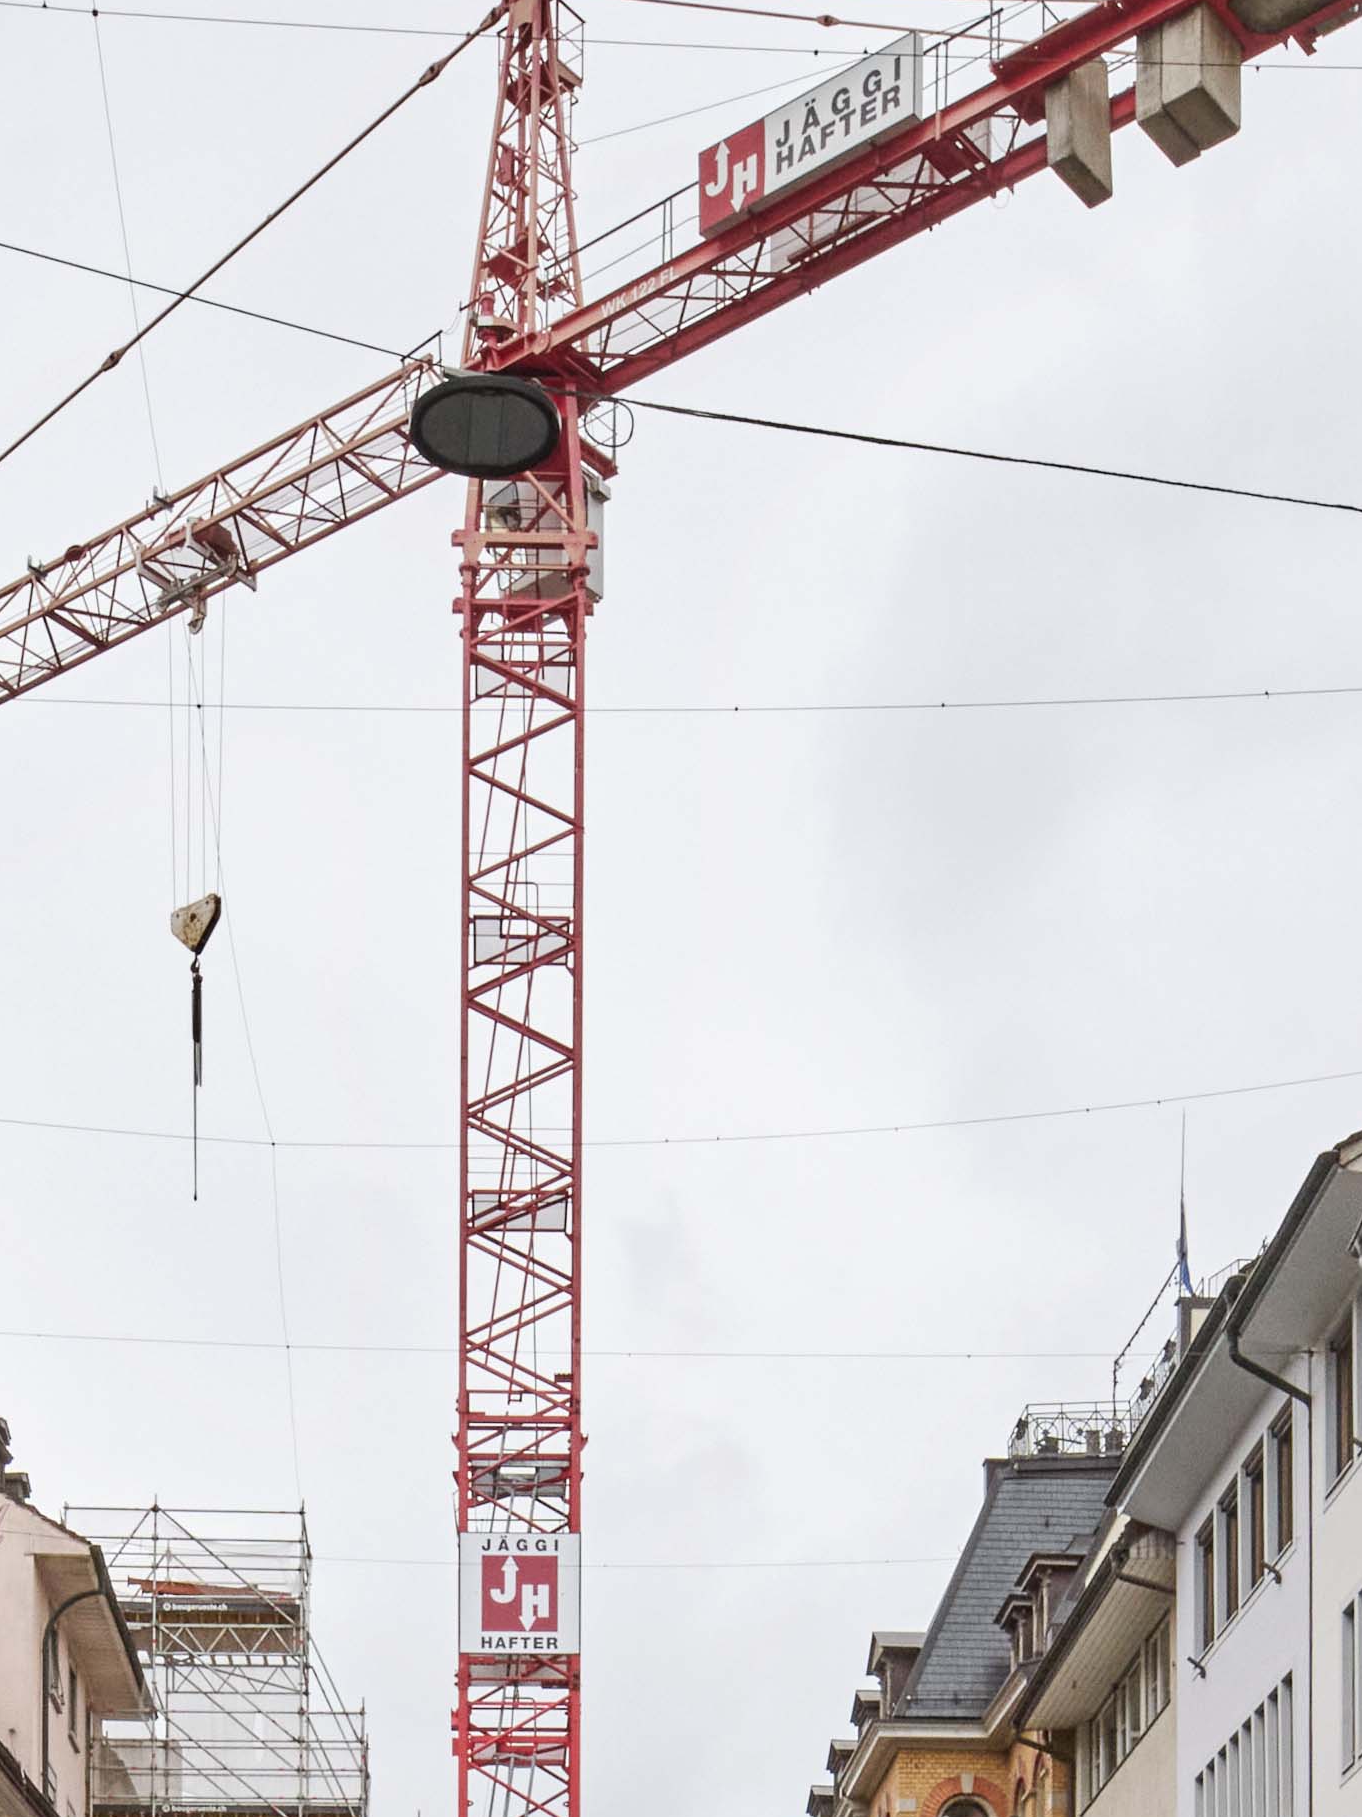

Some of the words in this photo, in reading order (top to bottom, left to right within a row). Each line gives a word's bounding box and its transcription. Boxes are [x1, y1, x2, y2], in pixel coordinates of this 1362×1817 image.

[775, 54, 901, 150] JÄGGI
[775, 84, 901, 176] HAFTER
[482, 1535, 558, 1551] JÄGGI
[481, 1636, 558, 1650] HAFTER
